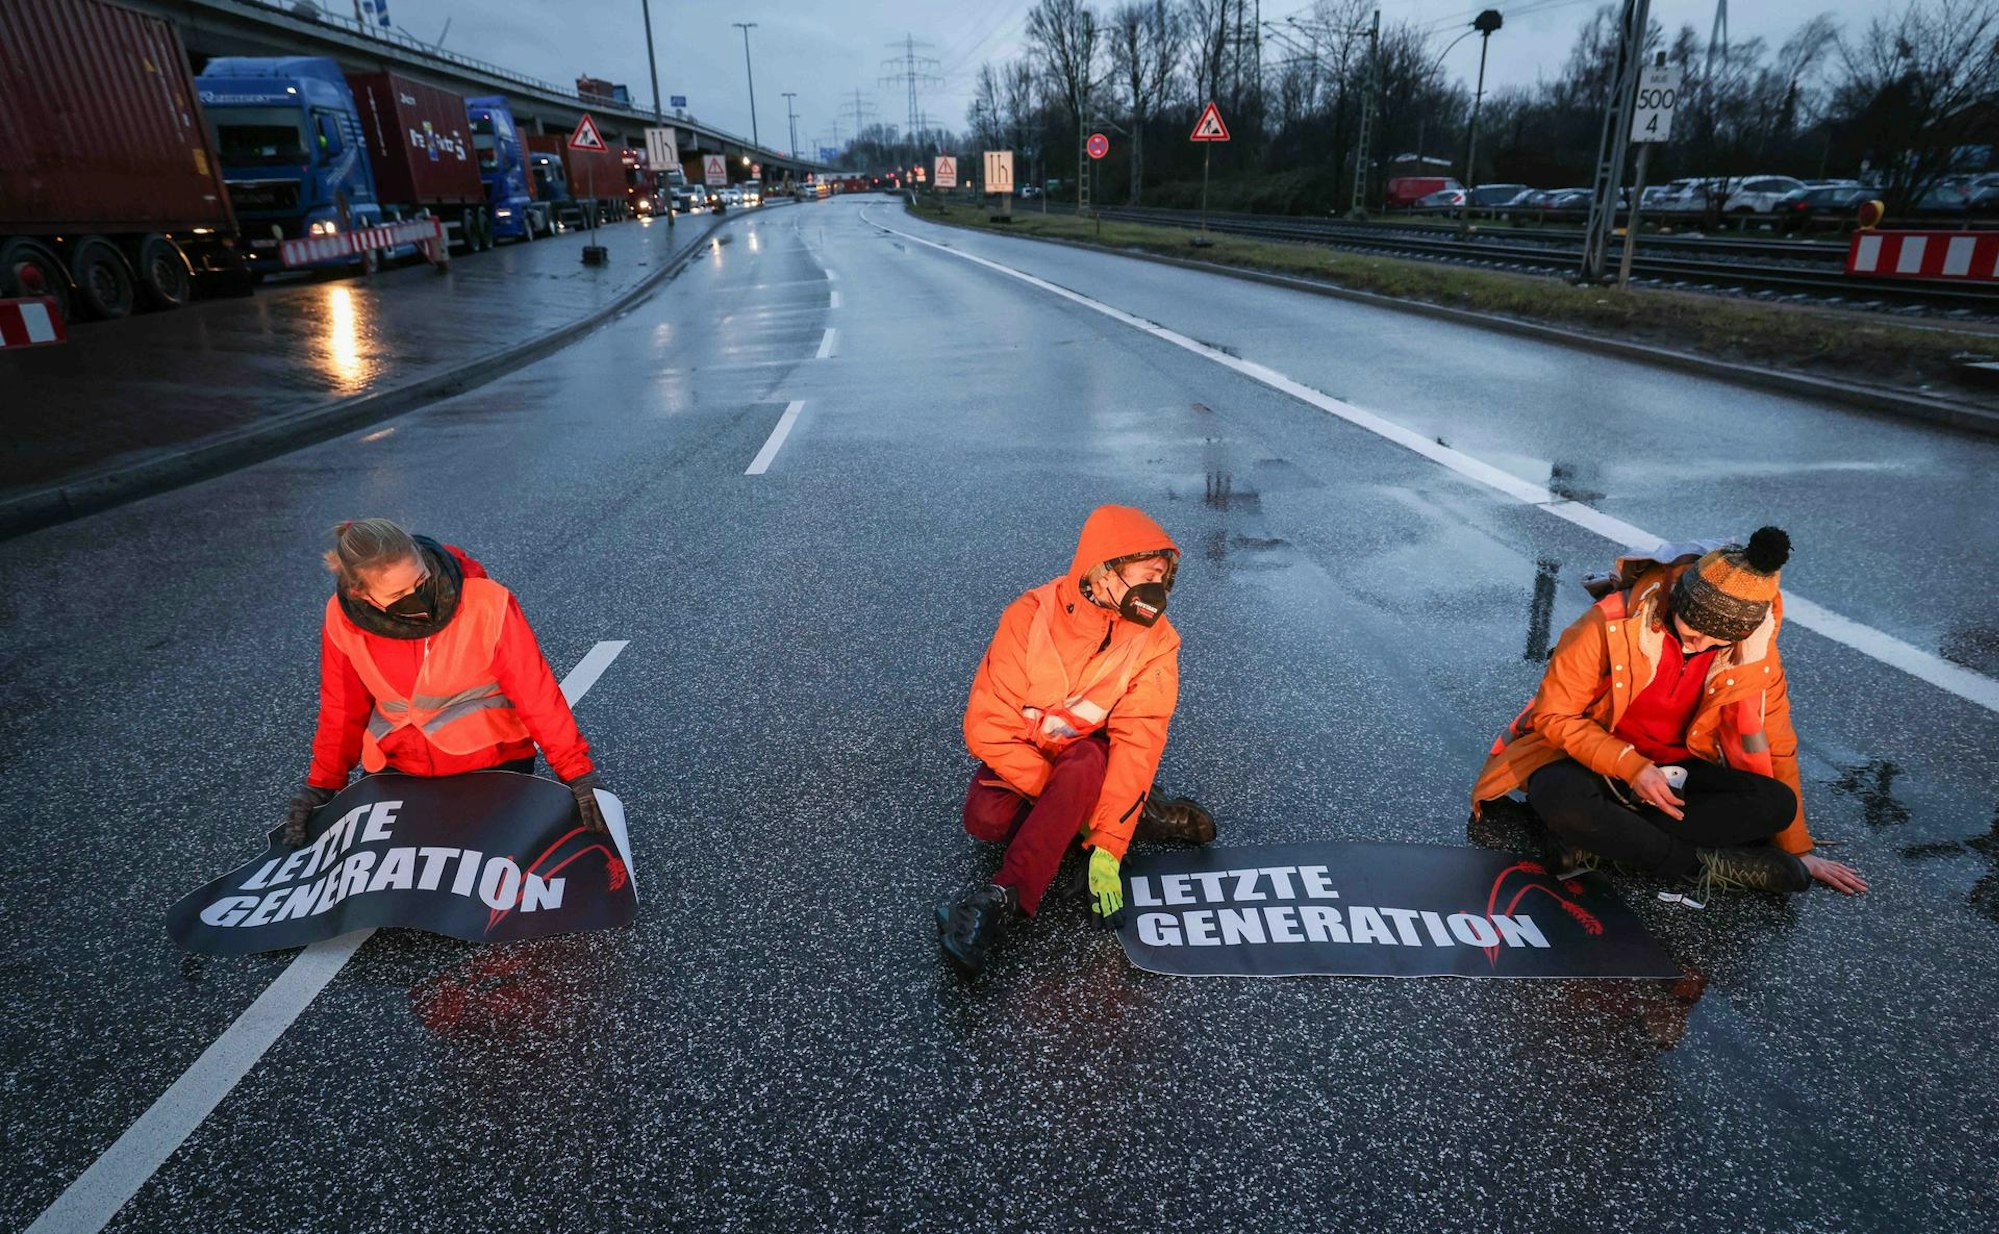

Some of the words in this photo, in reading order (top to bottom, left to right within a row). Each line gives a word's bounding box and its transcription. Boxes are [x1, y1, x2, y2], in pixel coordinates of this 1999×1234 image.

[1638, 88, 1675, 109] 500
[1645, 113, 1658, 133] 4
[238, 801, 404, 891] LETZTE
[200, 847, 565, 928] GENERATION
[1130, 865, 1339, 907] LETZTE
[1136, 906, 1551, 949] GENERATION
